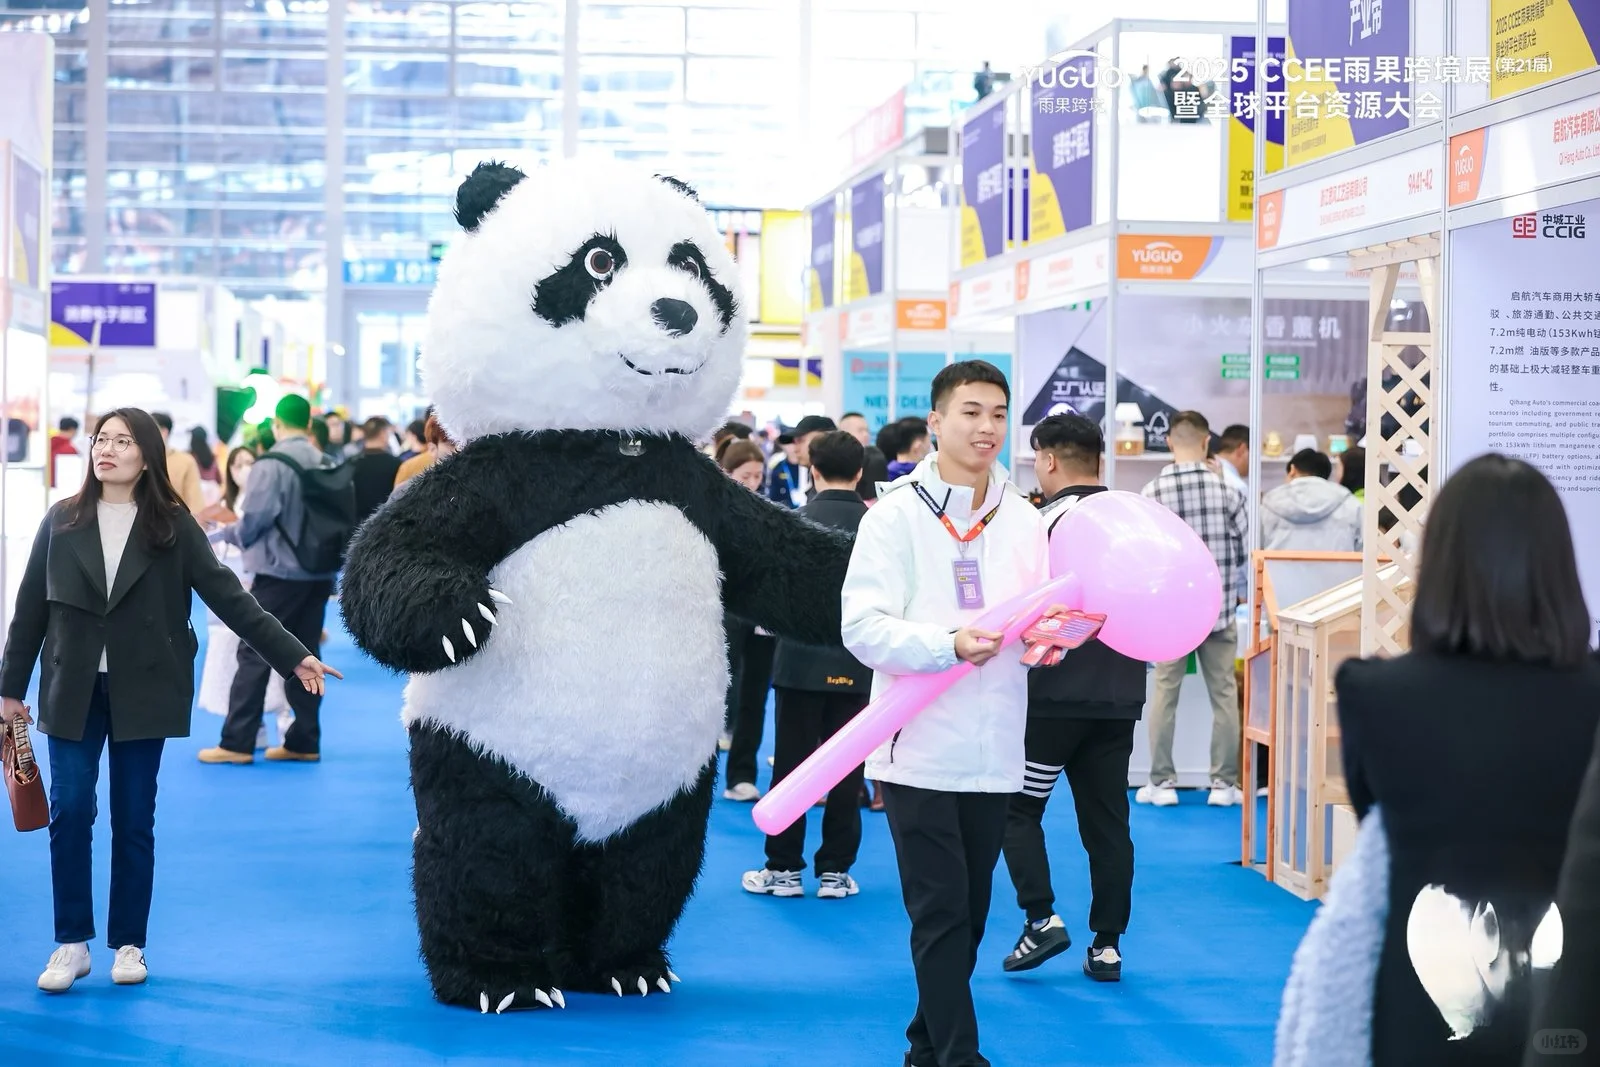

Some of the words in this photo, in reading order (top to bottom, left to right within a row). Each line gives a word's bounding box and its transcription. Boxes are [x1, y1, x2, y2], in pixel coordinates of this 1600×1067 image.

[1542, 214, 1585, 225] 中城工业
[1542, 226, 1586, 239] CCIG
[1131, 249, 1183, 263] YUGUO
[1511, 291, 1600, 302] 启航汽车商用大轿车
[1489, 363, 1600, 375] 的基础上极大减轻整车重
[1489, 381, 1504, 392] 性。
[1509, 399, 1532, 407] Qihang
[1521, 410, 1552, 418] including
[1515, 421, 1552, 429] commuting,
[1569, 421, 1589, 429] public
